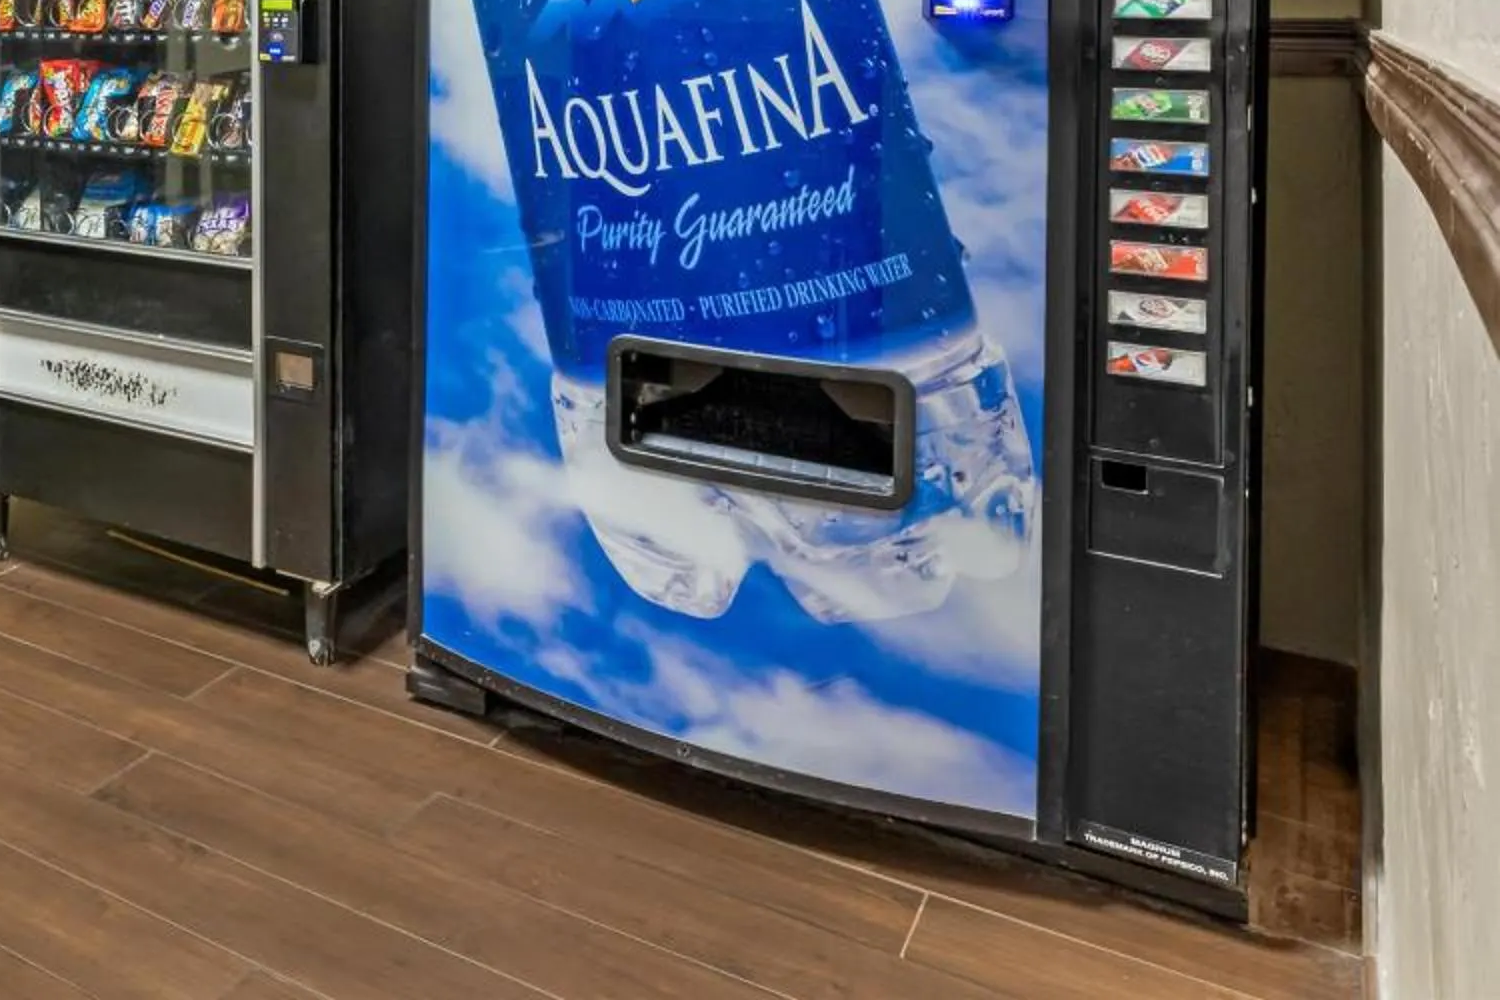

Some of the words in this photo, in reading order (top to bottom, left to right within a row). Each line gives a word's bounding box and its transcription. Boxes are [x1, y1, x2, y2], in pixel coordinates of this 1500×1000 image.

[577, 205, 667, 265] Purity
[673, 165, 857, 270] Guaranteed
[698, 285, 783, 320] PURIFIED
[784, 265, 869, 307] DRINKING
[863, 252, 914, 287] WATER
